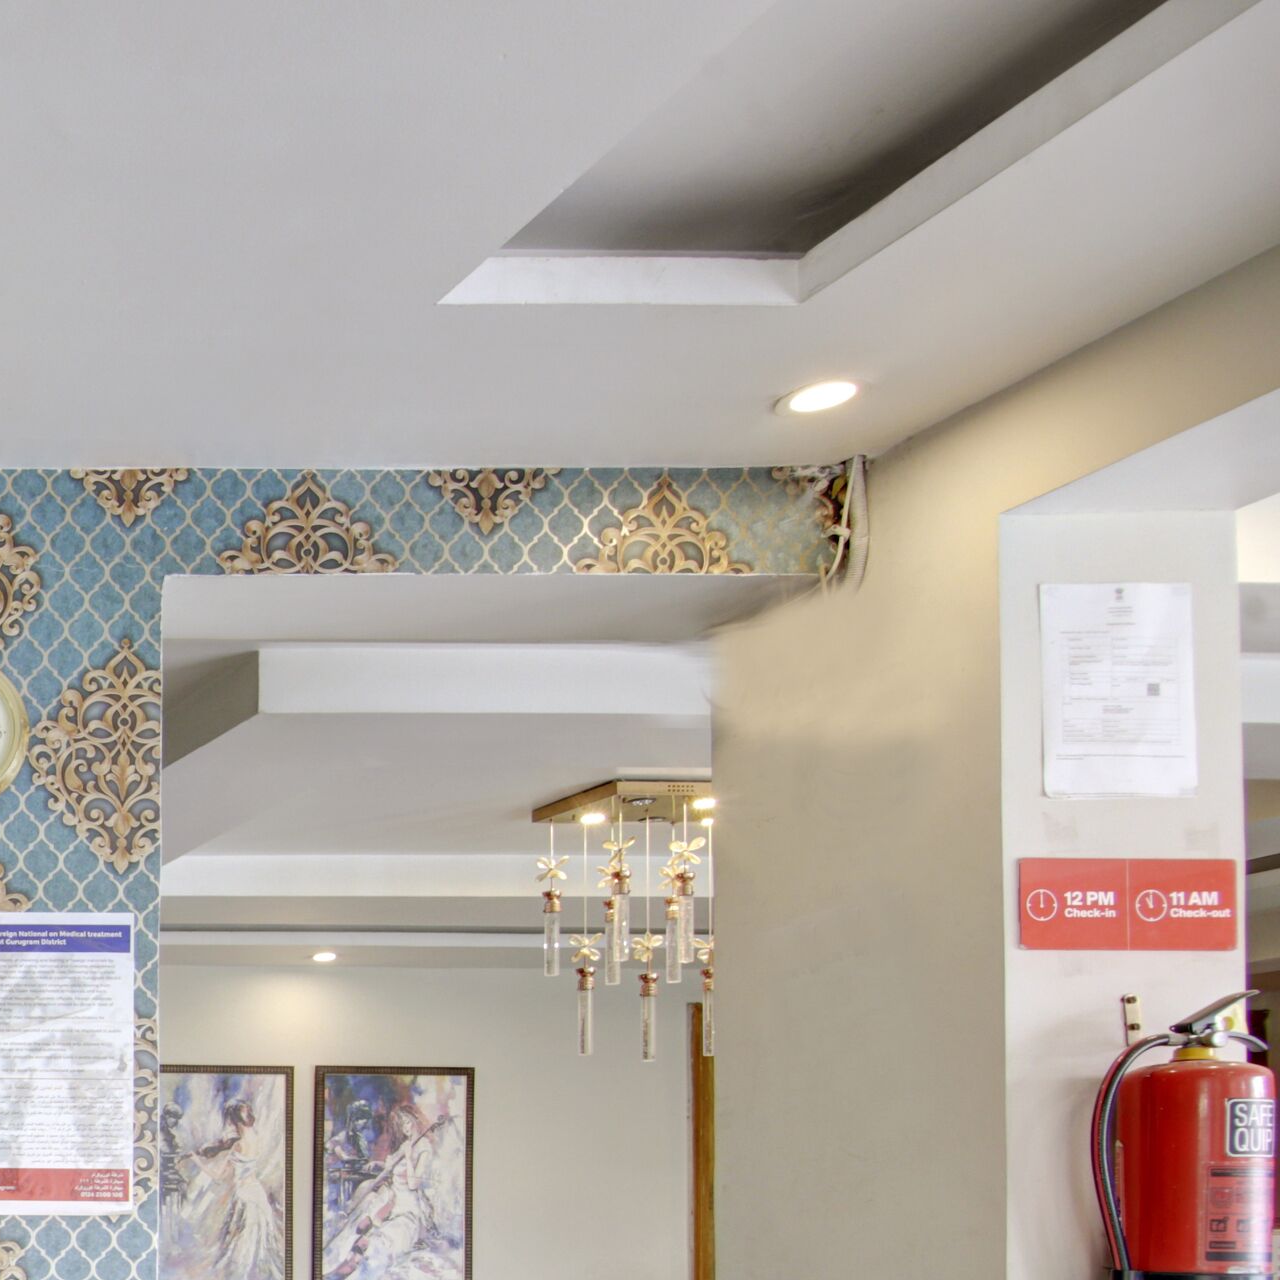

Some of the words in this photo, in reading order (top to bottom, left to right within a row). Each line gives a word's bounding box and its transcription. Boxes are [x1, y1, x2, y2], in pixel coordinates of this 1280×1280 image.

[1064, 891, 1082, 906] 12
[1086, 891, 1114, 906] PM
[1169, 891, 1185, 906] 11
[1188, 891, 1218, 906] AM
[1064, 908, 1116, 918] Check-in
[1169, 908, 1231, 918] Check-out
[5, 939, 40, 947] Gurugram
[1234, 1103, 1273, 1127] SAFE
